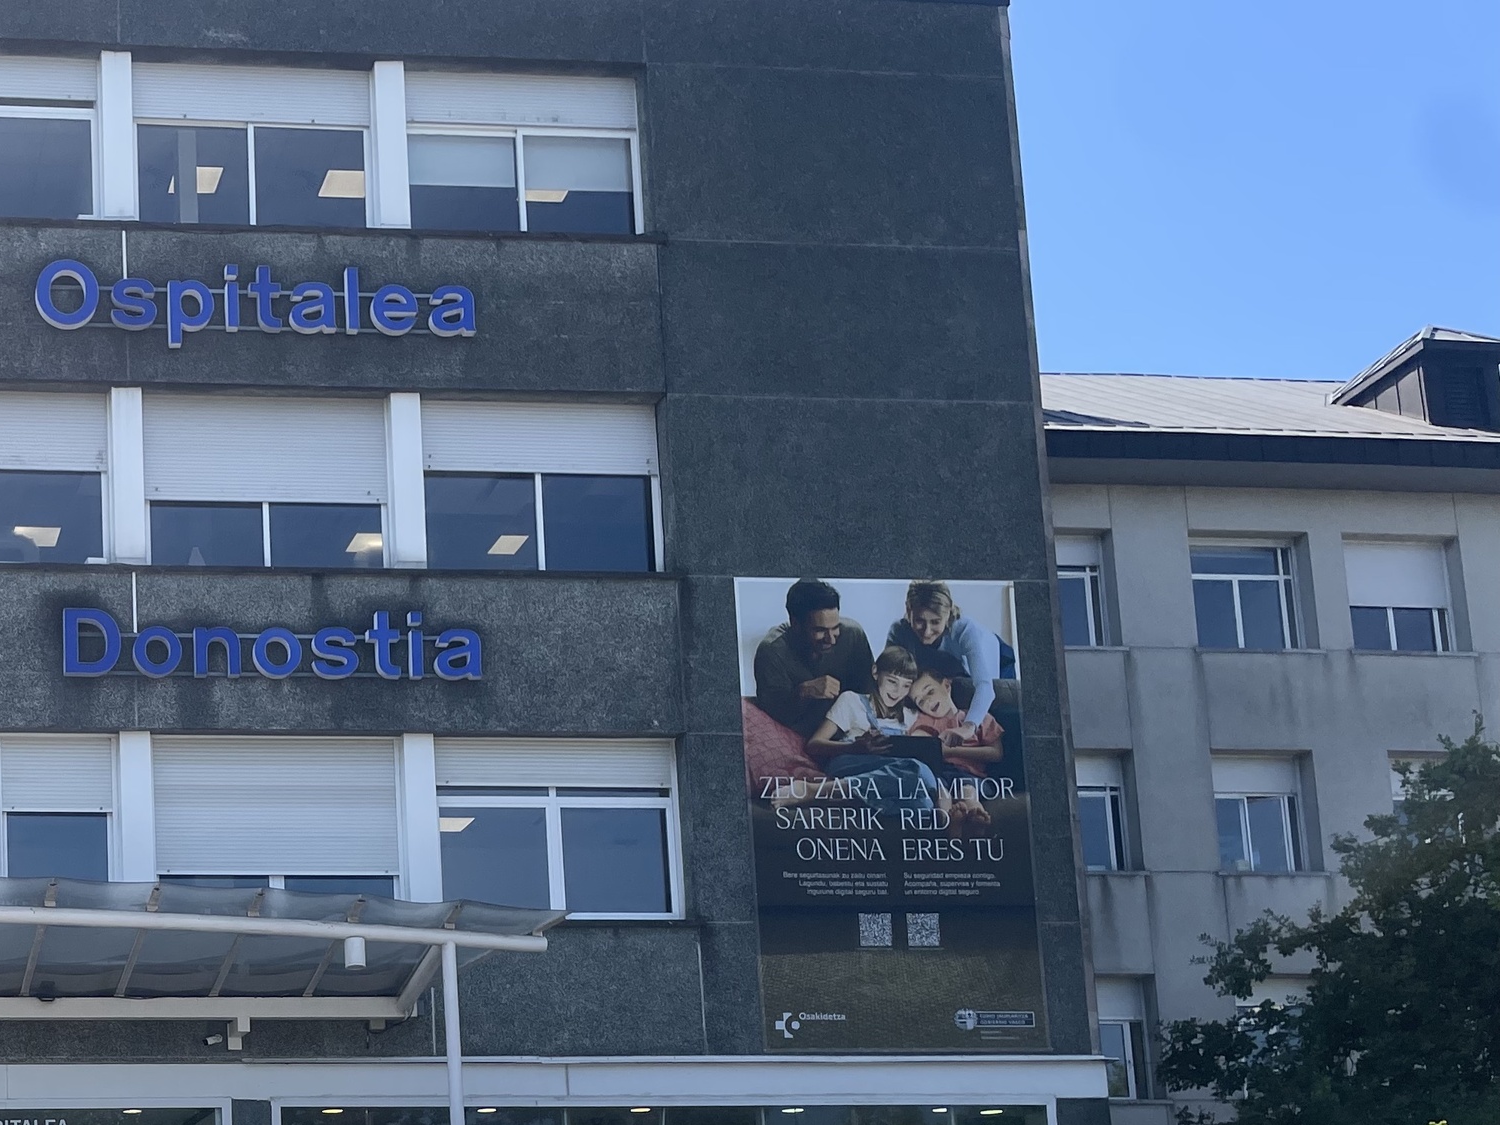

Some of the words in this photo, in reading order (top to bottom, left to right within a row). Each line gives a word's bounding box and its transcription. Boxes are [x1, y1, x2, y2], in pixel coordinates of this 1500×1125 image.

[34, 257, 478, 350] Ospitalea
[61, 606, 484, 681] Donostia
[759, 776, 808, 799] ZEU
[814, 776, 882, 800] ZARA
[898, 777, 930, 800] LA
[775, 807, 884, 830] SARERIK
[900, 808, 949, 830] RED
[796, 838, 886, 861] ONENA
[902, 838, 964, 861] ERES
[969, 833, 1004, 861] TÚ
[798, 1012, 846, 1020] Osakidetza
